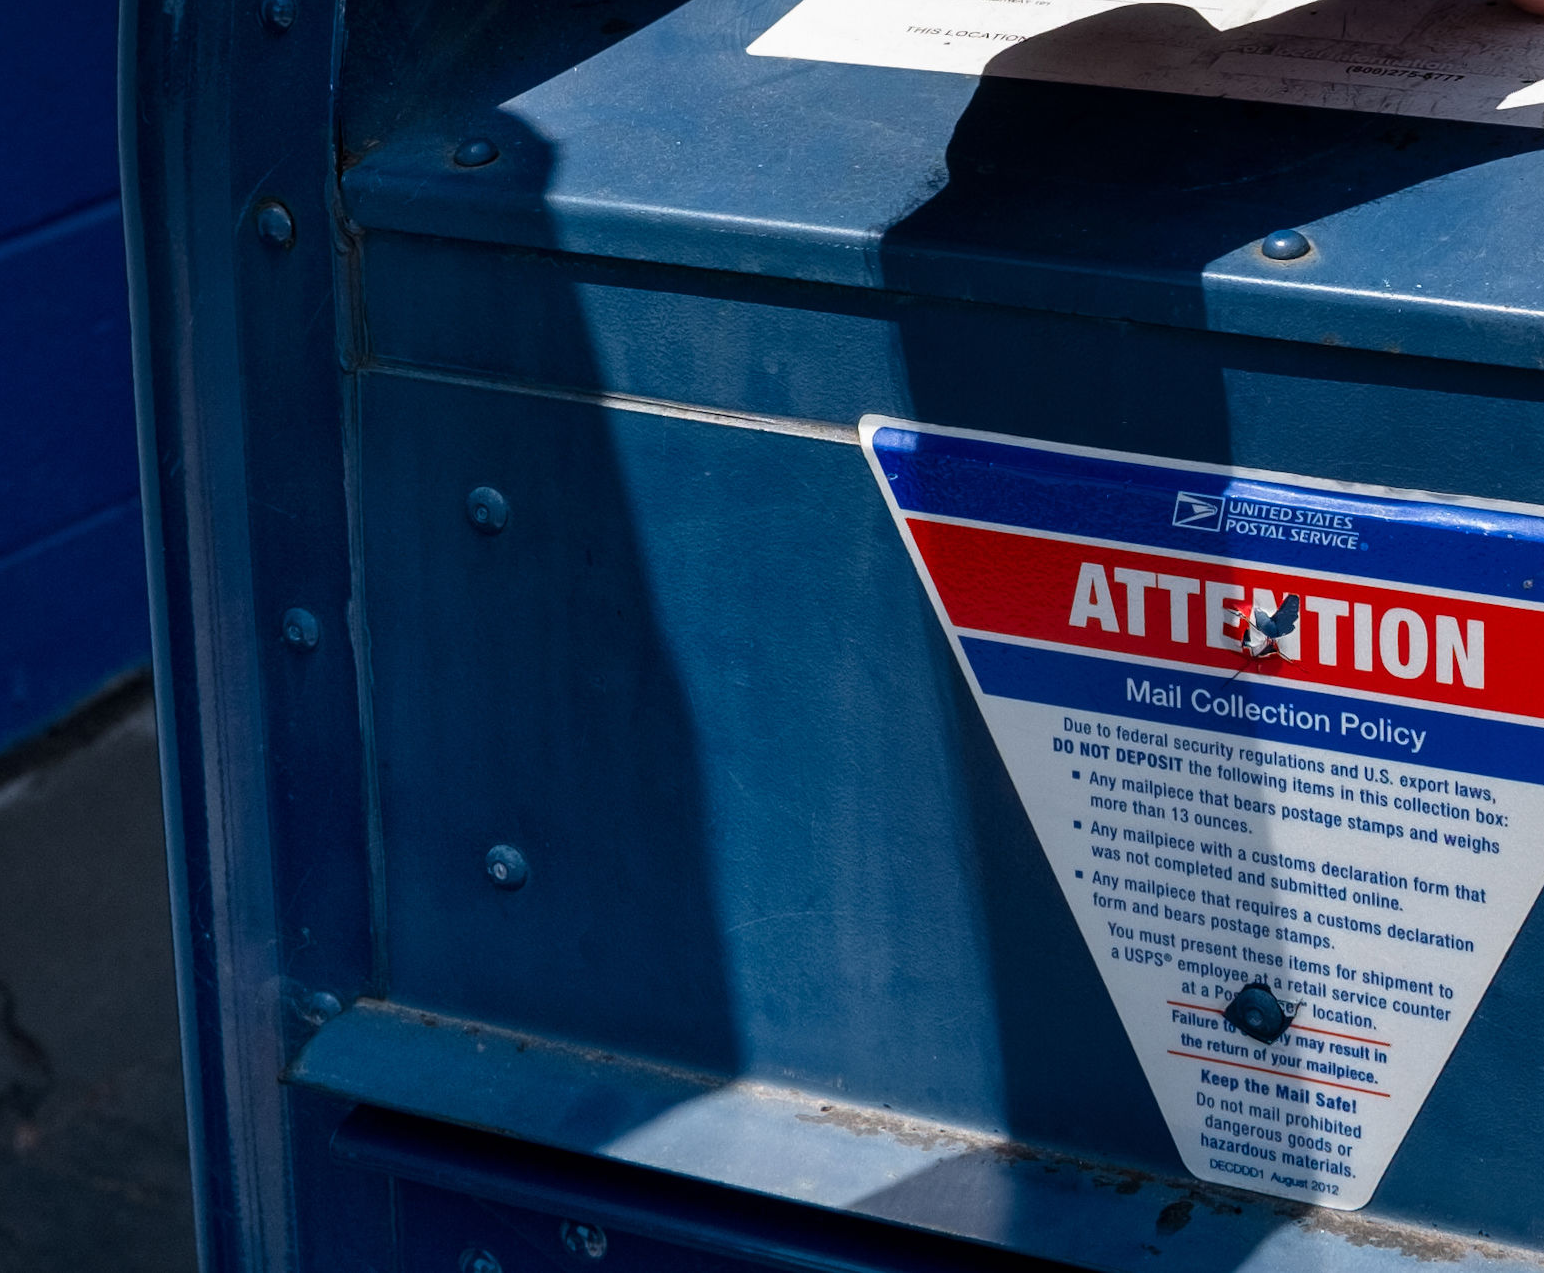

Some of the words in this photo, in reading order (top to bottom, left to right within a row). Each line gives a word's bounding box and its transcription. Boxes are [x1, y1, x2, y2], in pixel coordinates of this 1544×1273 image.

[905, 26, 943, 35] THIS
[944, 28, 1030, 43] LOCATION
[1226, 519, 1287, 541] POSTAL
[1289, 528, 1358, 550] SERVICE
[1229, 501, 1292, 521] UNITED
[1295, 510, 1353, 530] STATES
[1068, 561, 1485, 690] ATTENTION
[1126, 677, 1182, 710] Mail
[1191, 688, 1331, 734] Collection
[1341, 712, 1427, 754] Policy
[1053, 737, 1074, 754] DO
[1080, 741, 1110, 759] NOT
[1116, 748, 1183, 772] DEPOSIT
[1189, 760, 1212, 777] the
[1217, 764, 1287, 793] following
[1293, 777, 1334, 798] items
[1341, 785, 1354, 801] in
[1360, 789, 1388, 807] this
[1394, 797, 1469, 821] collection
[1476, 808, 1508, 827] box:
[1064, 717, 1092, 735] Due
[1097, 723, 1111, 739] to
[1117, 725, 1168, 748] federal
[1174, 736, 1233, 761] security
[1239, 746, 1325, 774] regulations
[1331, 763, 1358, 779] and
[1364, 766, 1394, 785] U.S.
[1400, 774, 1449, 795] export
[1455, 781, 1496, 804] laws,
[1089, 771, 1116, 791] Any
[1122, 777, 1194, 801] mailpiece
[1199, 789, 1229, 808] that
[1234, 795, 1276, 816] bears
[1282, 805, 1342, 827] postage
[1348, 816, 1404, 838] stamps
[1410, 827, 1438, 844] and
[1444, 833, 1500, 854] weighs
[1090, 795, 1127, 813] more
[1133, 800, 1165, 819] than
[1171, 807, 1189, 823] 13
[1194, 813, 1252, 834] ounces.
[1090, 821, 1117, 841] Any
[1123, 828, 1195, 853] mailpiece
[1200, 840, 1232, 859] with
[1238, 848, 1246, 861] a
[1252, 850, 1316, 873] customs
[1322, 861, 1408, 889] declaration
[1413, 877, 1449, 897] form
[1455, 884, 1486, 904] that
[1092, 845, 1121, 861] was
[1127, 851, 1149, 866] not
[1155, 856, 1232, 881] completed
[1238, 870, 1265, 887] and
[1271, 876, 1347, 901] submitted
[1353, 891, 1404, 912] online.
[1092, 870, 1119, 890] Any
[1124, 878, 1196, 902] mailpiece
[1201, 889, 1230, 909] that
[1236, 897, 1298, 921] requires
[1303, 909, 1312, 923] a
[1317, 913, 1382, 936] customs
[1387, 924, 1474, 953] declaration
[1093, 892, 1127, 912] form
[1132, 901, 1159, 918] and
[1164, 905, 1206, 926] bears
[1211, 915, 1270, 939] postage
[1275, 927, 1335, 950] stamps.
[1107, 922, 1134, 939] You
[1139, 931, 1175, 948] must
[1181, 938, 1237, 959] present
[1242, 947, 1283, 968] these
[1289, 955, 1331, 976] items
[1336, 964, 1358, 981] for
[1362, 970, 1434, 997] shipment
[1439, 983, 1454, 1000] to
[1111, 947, 1120, 959] a
[1177, 959, 1249, 983] employee
[1255, 973, 1268, 984] at
[1274, 977, 1282, 989] a
[1288, 977, 1327, 997] retail
[1332, 988, 1387, 1010] service
[1392, 1000, 1451, 1022] counter
[1182, 980, 1197, 996] at
[1201, 984, 1209, 997] a
[1215, 985, 1240, 1002] Pos
[1313, 1004, 1376, 1030] location.
[1172, 1009, 1219, 1030] Failure
[1223, 1019, 1236, 1034] to
[1295, 1033, 1325, 1053] may
[1330, 1042, 1370, 1060] result
[1374, 1049, 1387, 1064] in
[1181, 1033, 1202, 1049] the
[1207, 1039, 1249, 1058] return
[1254, 1048, 1267, 1061] of
[1271, 1053, 1302, 1068] your
[1306, 1059, 1378, 1084] mailpiece.
[1196, 1092, 1215, 1109] Do
[1220, 1099, 1243, 1115] not
[1249, 1105, 1280, 1122] mail
[1286, 1113, 1362, 1139] prohibited
[1201, 1069, 1239, 1091] Keep
[1244, 1079, 1270, 1096] the
[1276, 1084, 1310, 1104] Mail
[1316, 1093, 1357, 1114] Safe!
[1201, 1132, 1277, 1162] hazardous
[1282, 1152, 1356, 1179] materials.
[1205, 1114, 1282, 1142] dangerous
[1288, 1133, 1332, 1153] goods
[1337, 1145, 1353, 1157] or
[1271, 1172, 1308, 1189] August
[1311, 1180, 1339, 1196] 2012
